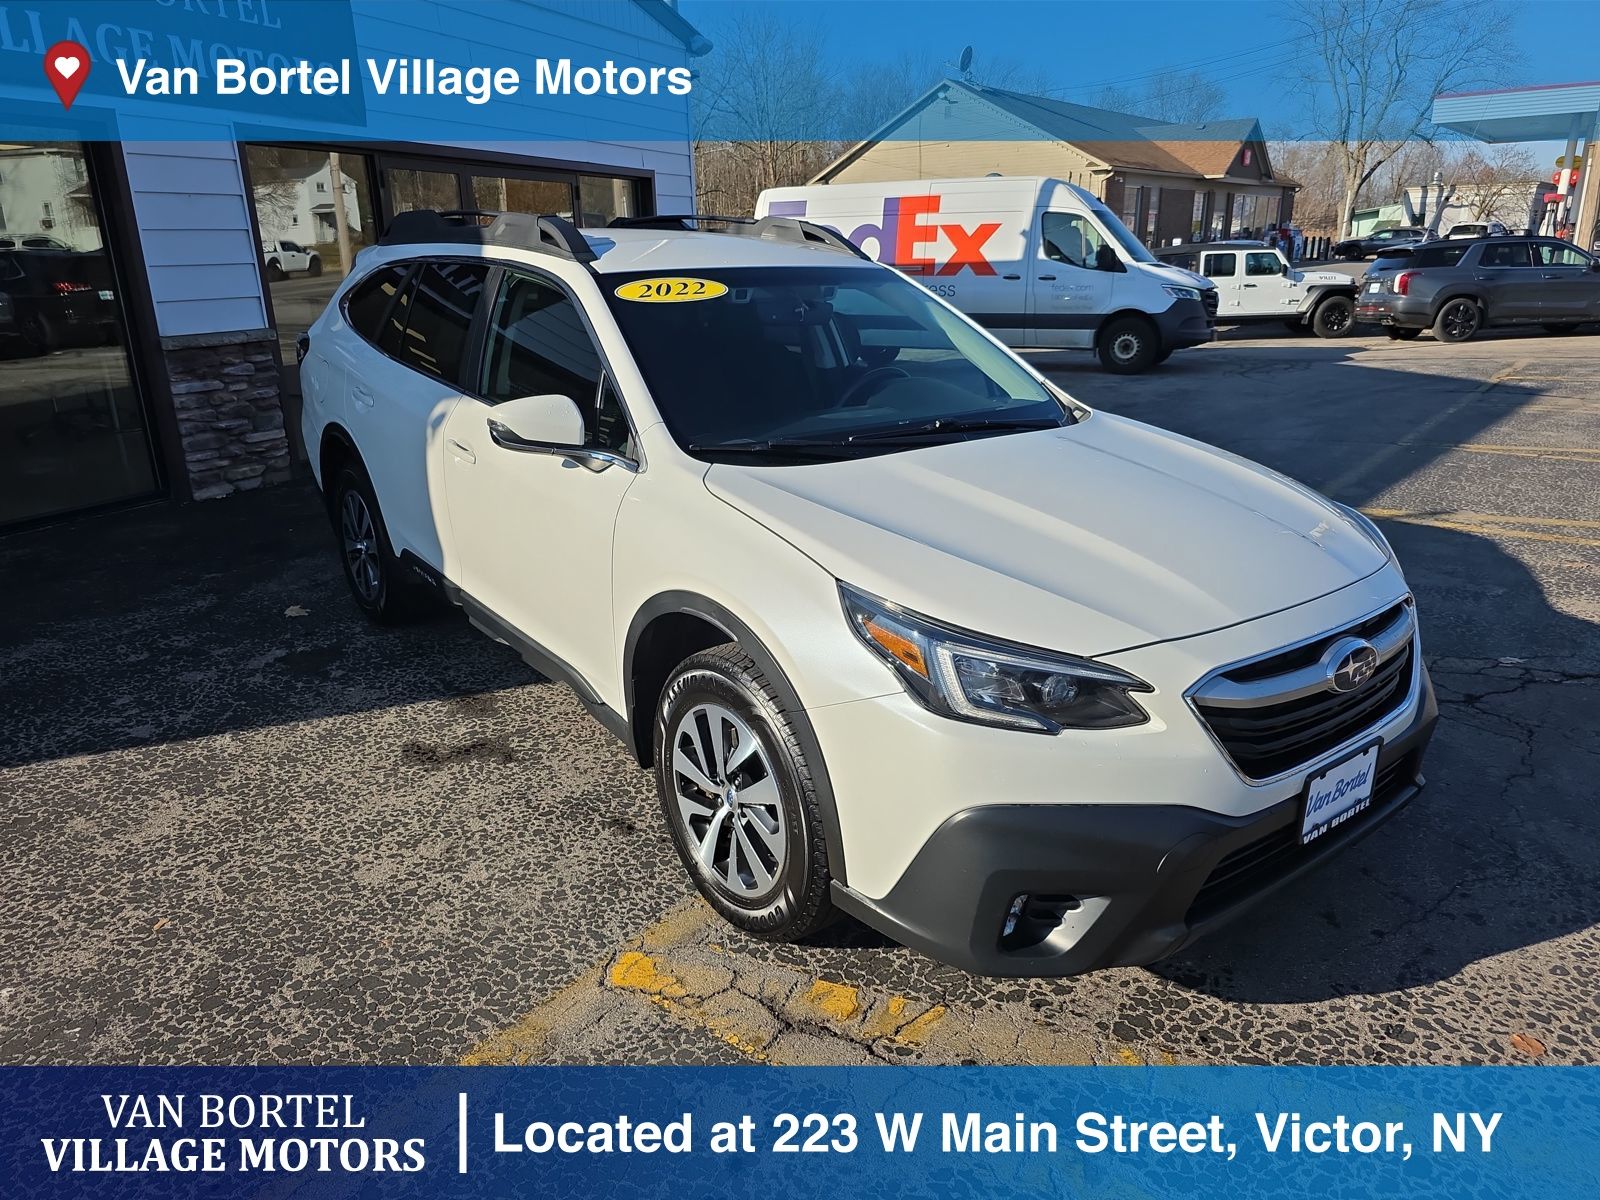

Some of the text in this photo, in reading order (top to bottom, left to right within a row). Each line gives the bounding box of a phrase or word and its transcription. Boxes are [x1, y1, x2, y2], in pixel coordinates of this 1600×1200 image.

[768, 195, 1002, 276] dEx
[638, 281, 707, 299] 2022
[925, 284, 956, 297] ess
[1306, 762, 1372, 818] Van Bortel
[1303, 798, 1371, 845] VAN BORTEL
